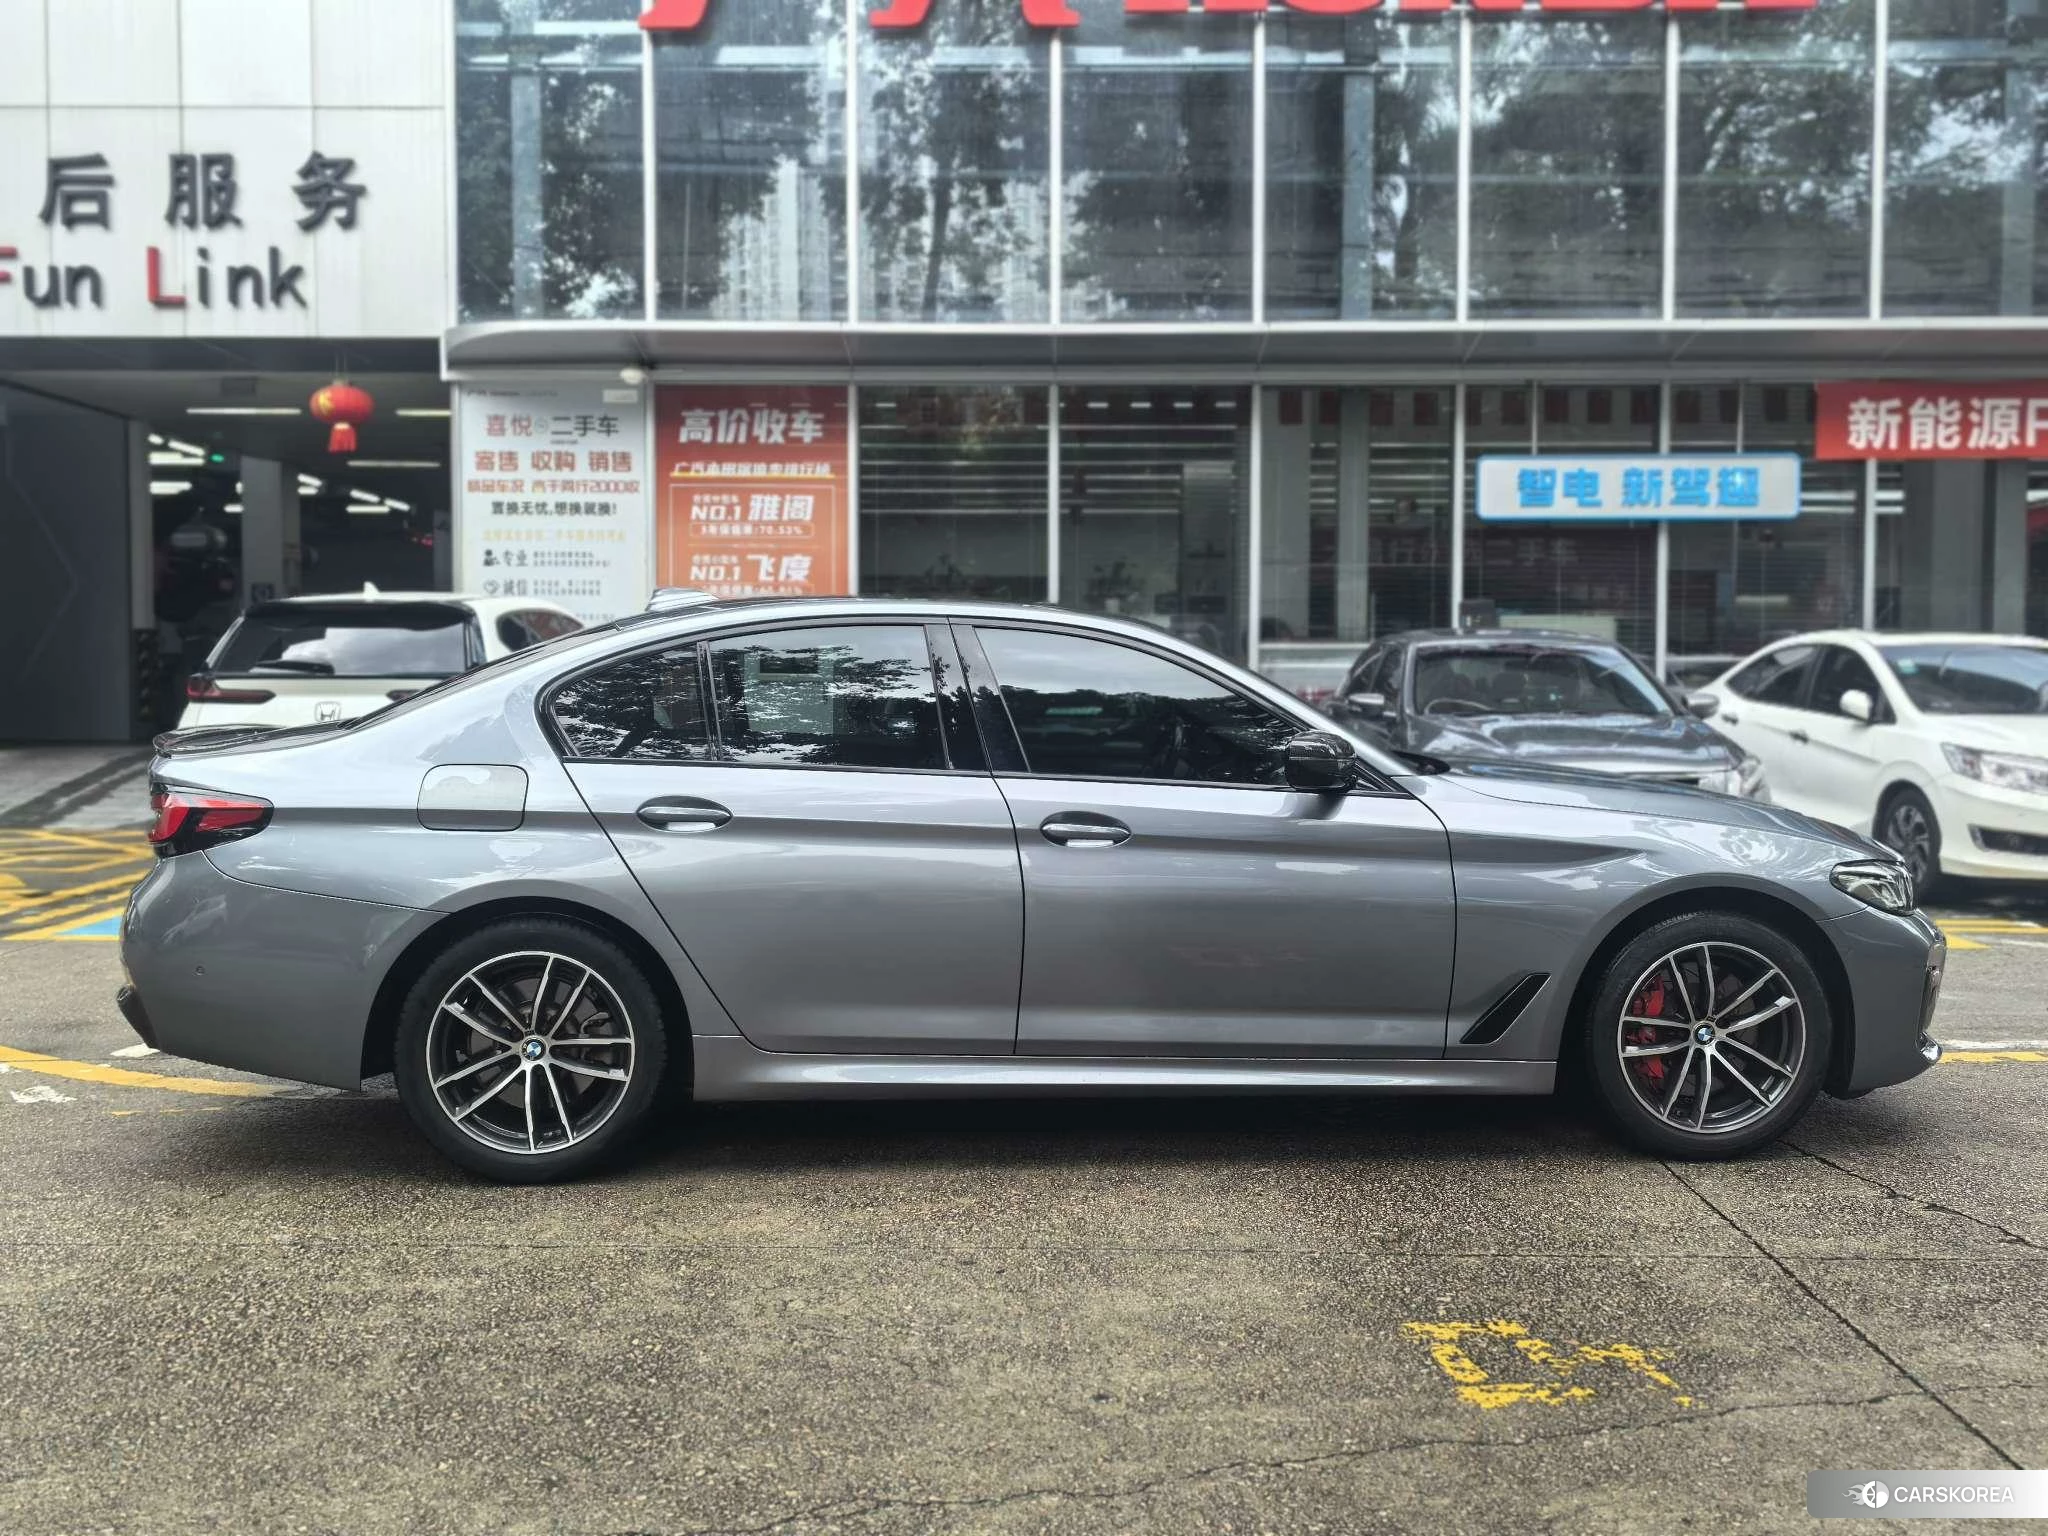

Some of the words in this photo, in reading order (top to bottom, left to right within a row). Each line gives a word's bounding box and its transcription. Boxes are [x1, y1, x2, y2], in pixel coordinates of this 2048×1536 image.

[147, 246, 308, 309] Link
[551, 414, 620, 438] 二手车
[678, 408, 825, 445] 高价收车
[531, 451, 577, 473] 收购
[588, 451, 633, 473] 销售
[1517, 467, 1602, 508] 智电
[691, 505, 741, 521] NO.1
[748, 494, 815, 521] 雅阁
[690, 565, 741, 582] NO.1
[746, 554, 813, 582] 飞度
